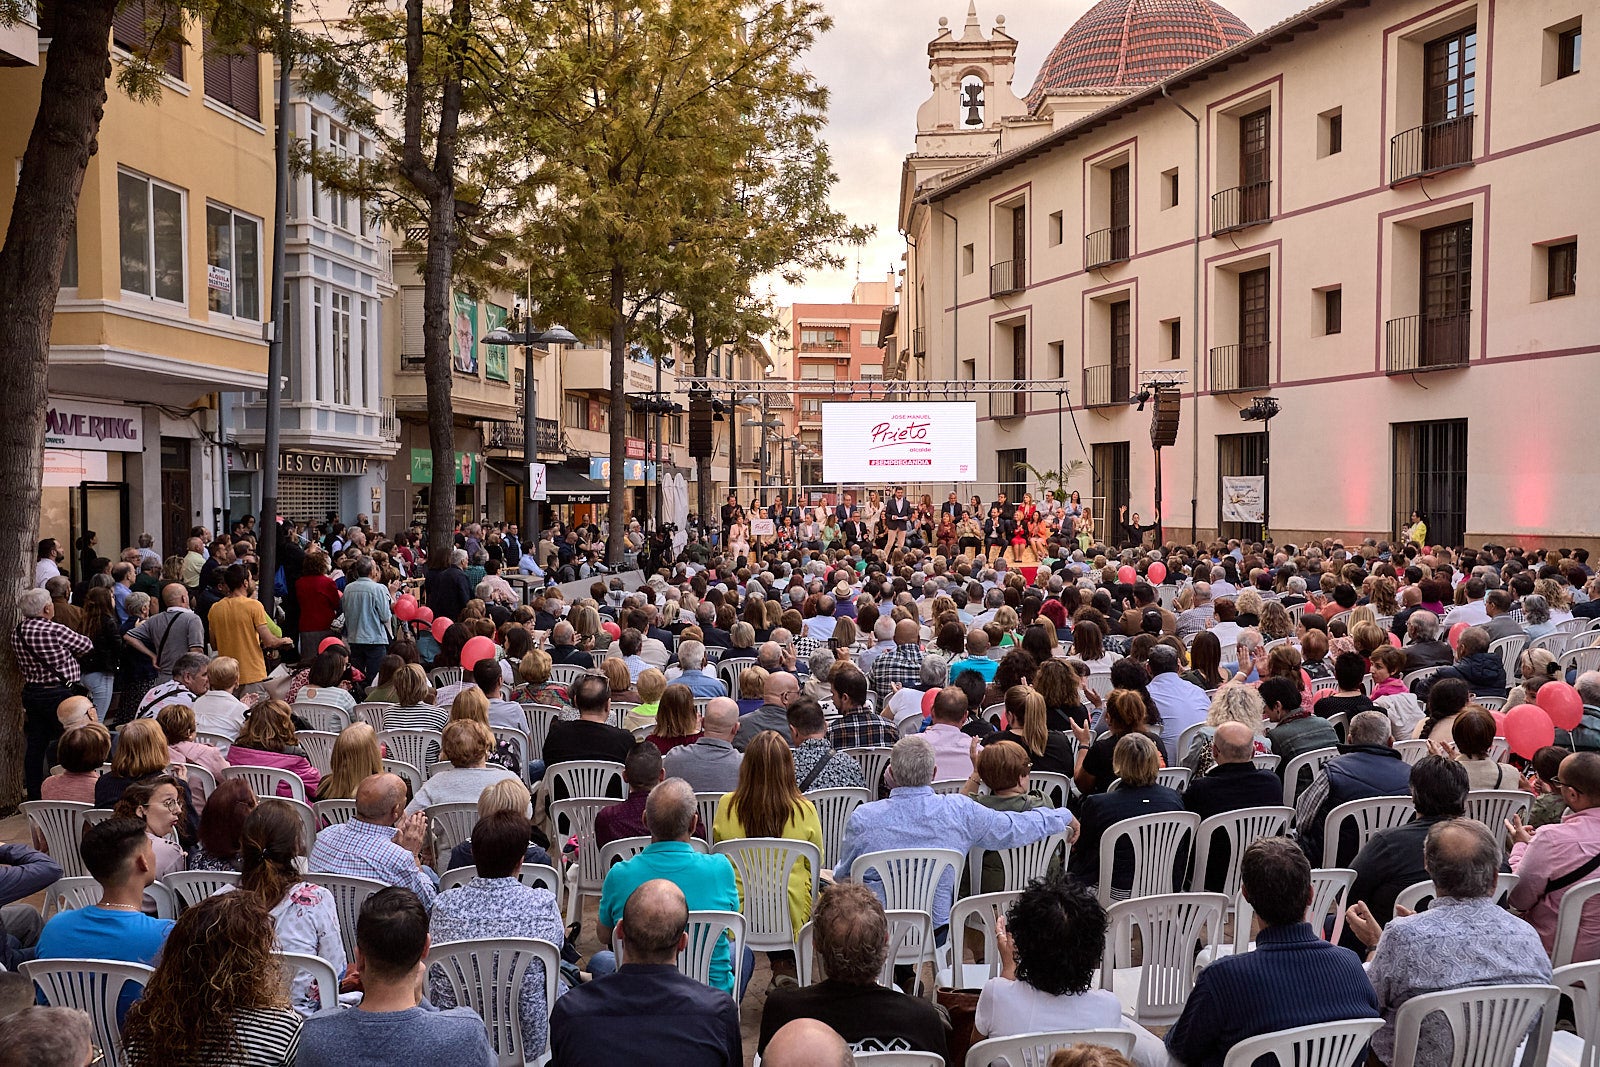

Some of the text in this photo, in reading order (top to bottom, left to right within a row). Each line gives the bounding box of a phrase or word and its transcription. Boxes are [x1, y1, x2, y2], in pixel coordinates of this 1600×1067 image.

[208, 272, 230, 282] ALQUILA
[871, 421, 930, 442] Prieto
[241, 451, 368, 474] VIJES GANDIA
